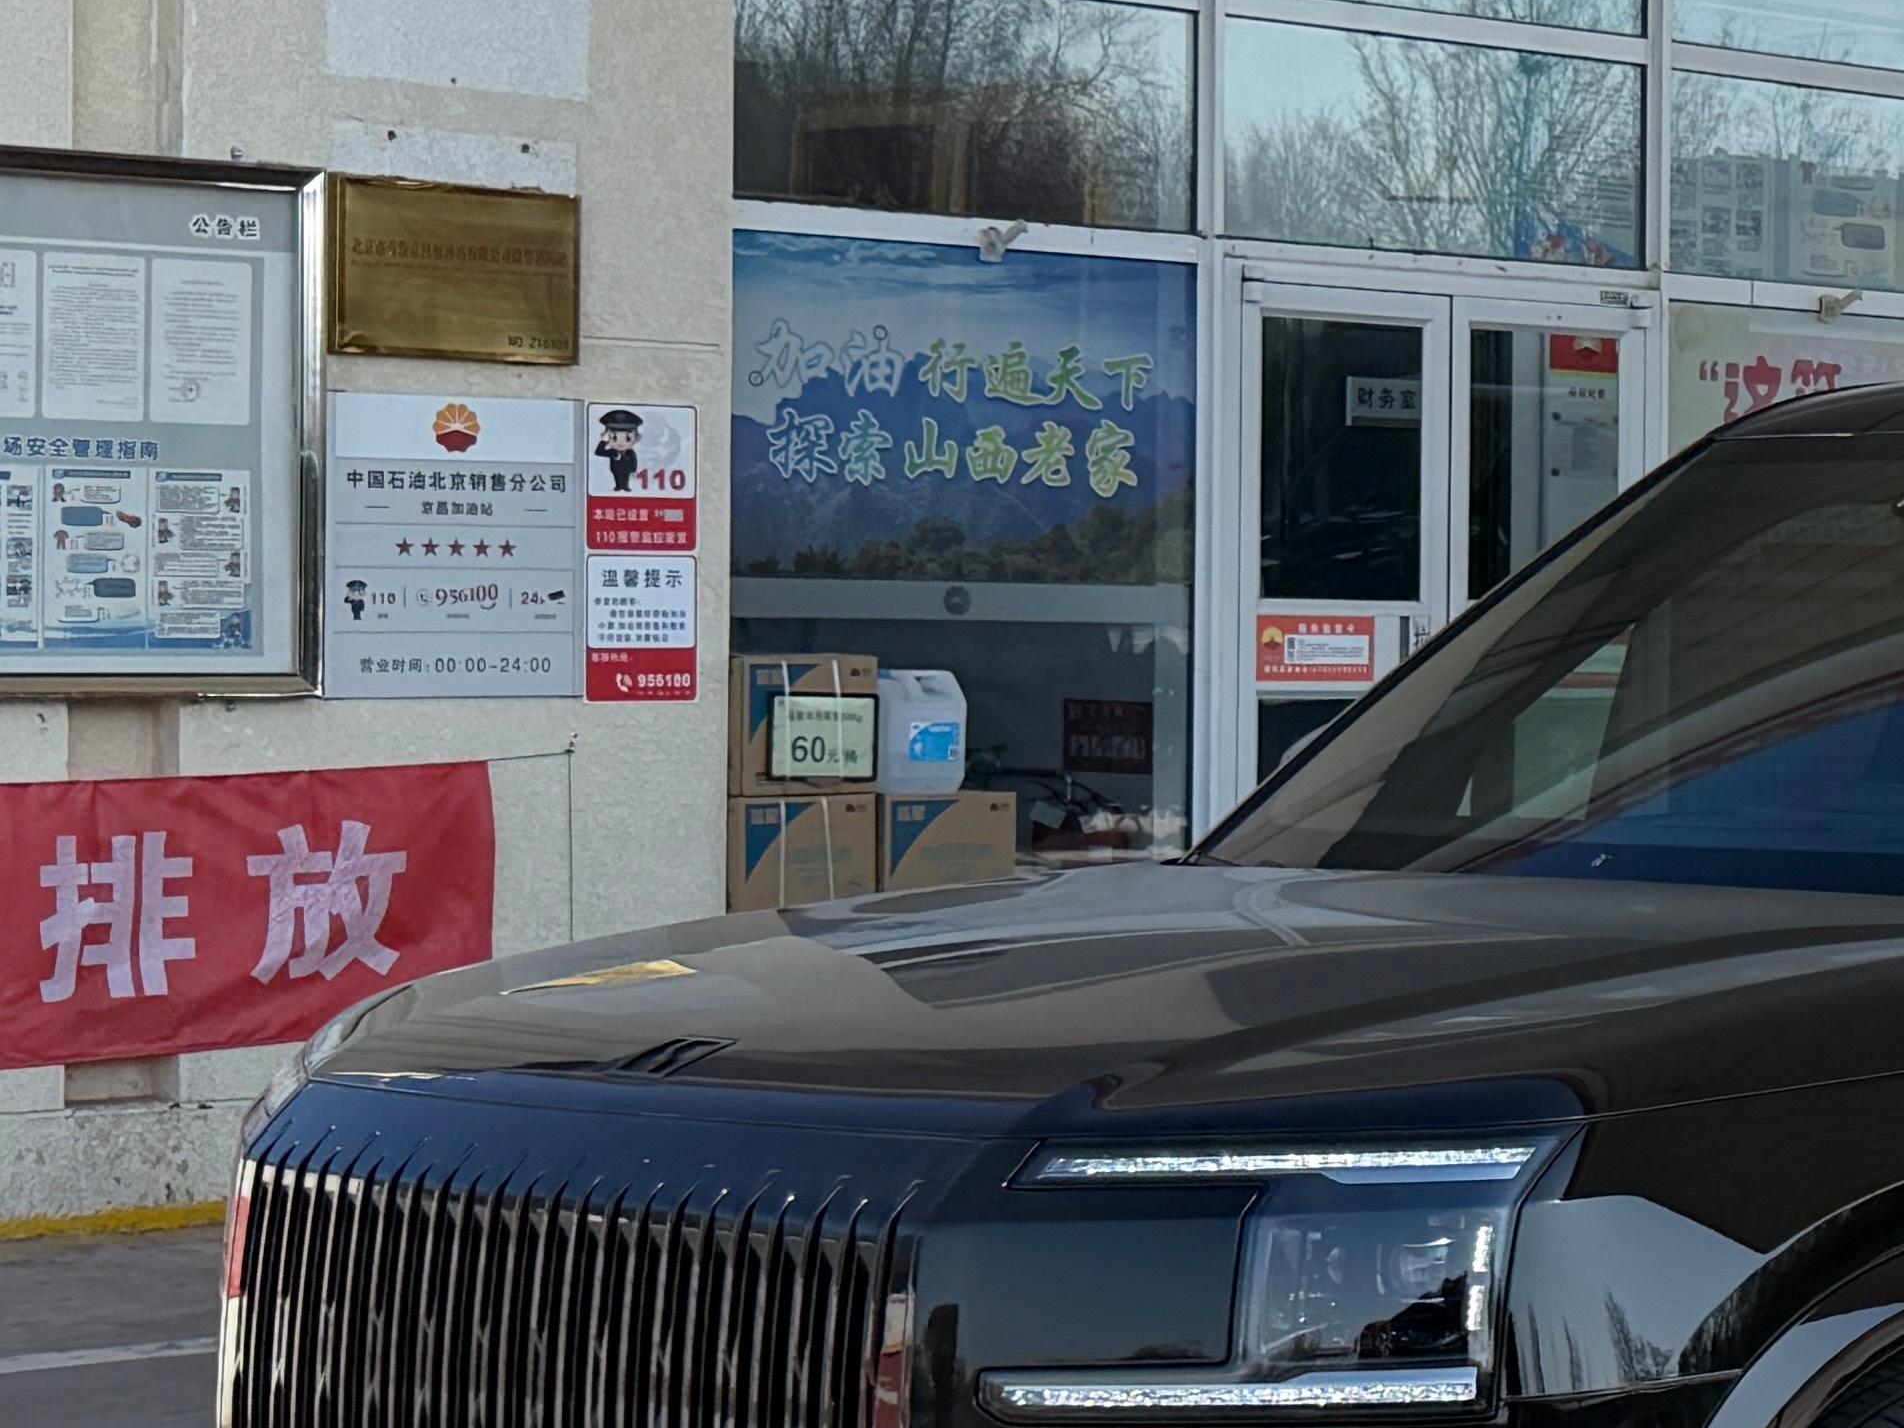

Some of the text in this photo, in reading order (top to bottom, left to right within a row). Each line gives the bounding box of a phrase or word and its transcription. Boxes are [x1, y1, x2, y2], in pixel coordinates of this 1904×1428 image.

[190, 215, 260, 239] 公告栏
[755, 318, 1153, 411] 加油行遍天下
[1356, 387, 1418, 410] 财务室
[766, 407, 1138, 498] 探索山西老家
[346, 469, 567, 493] 中国石油北京销售分公司
[636, 468, 686, 490] 110
[421, 501, 494, 516] 京昌加油站
[602, 569, 683, 588] 温馨提示
[371, 592, 396, 605] 110
[435, 584, 498, 606] 956100
[39, 819, 408, 1003] 排放
